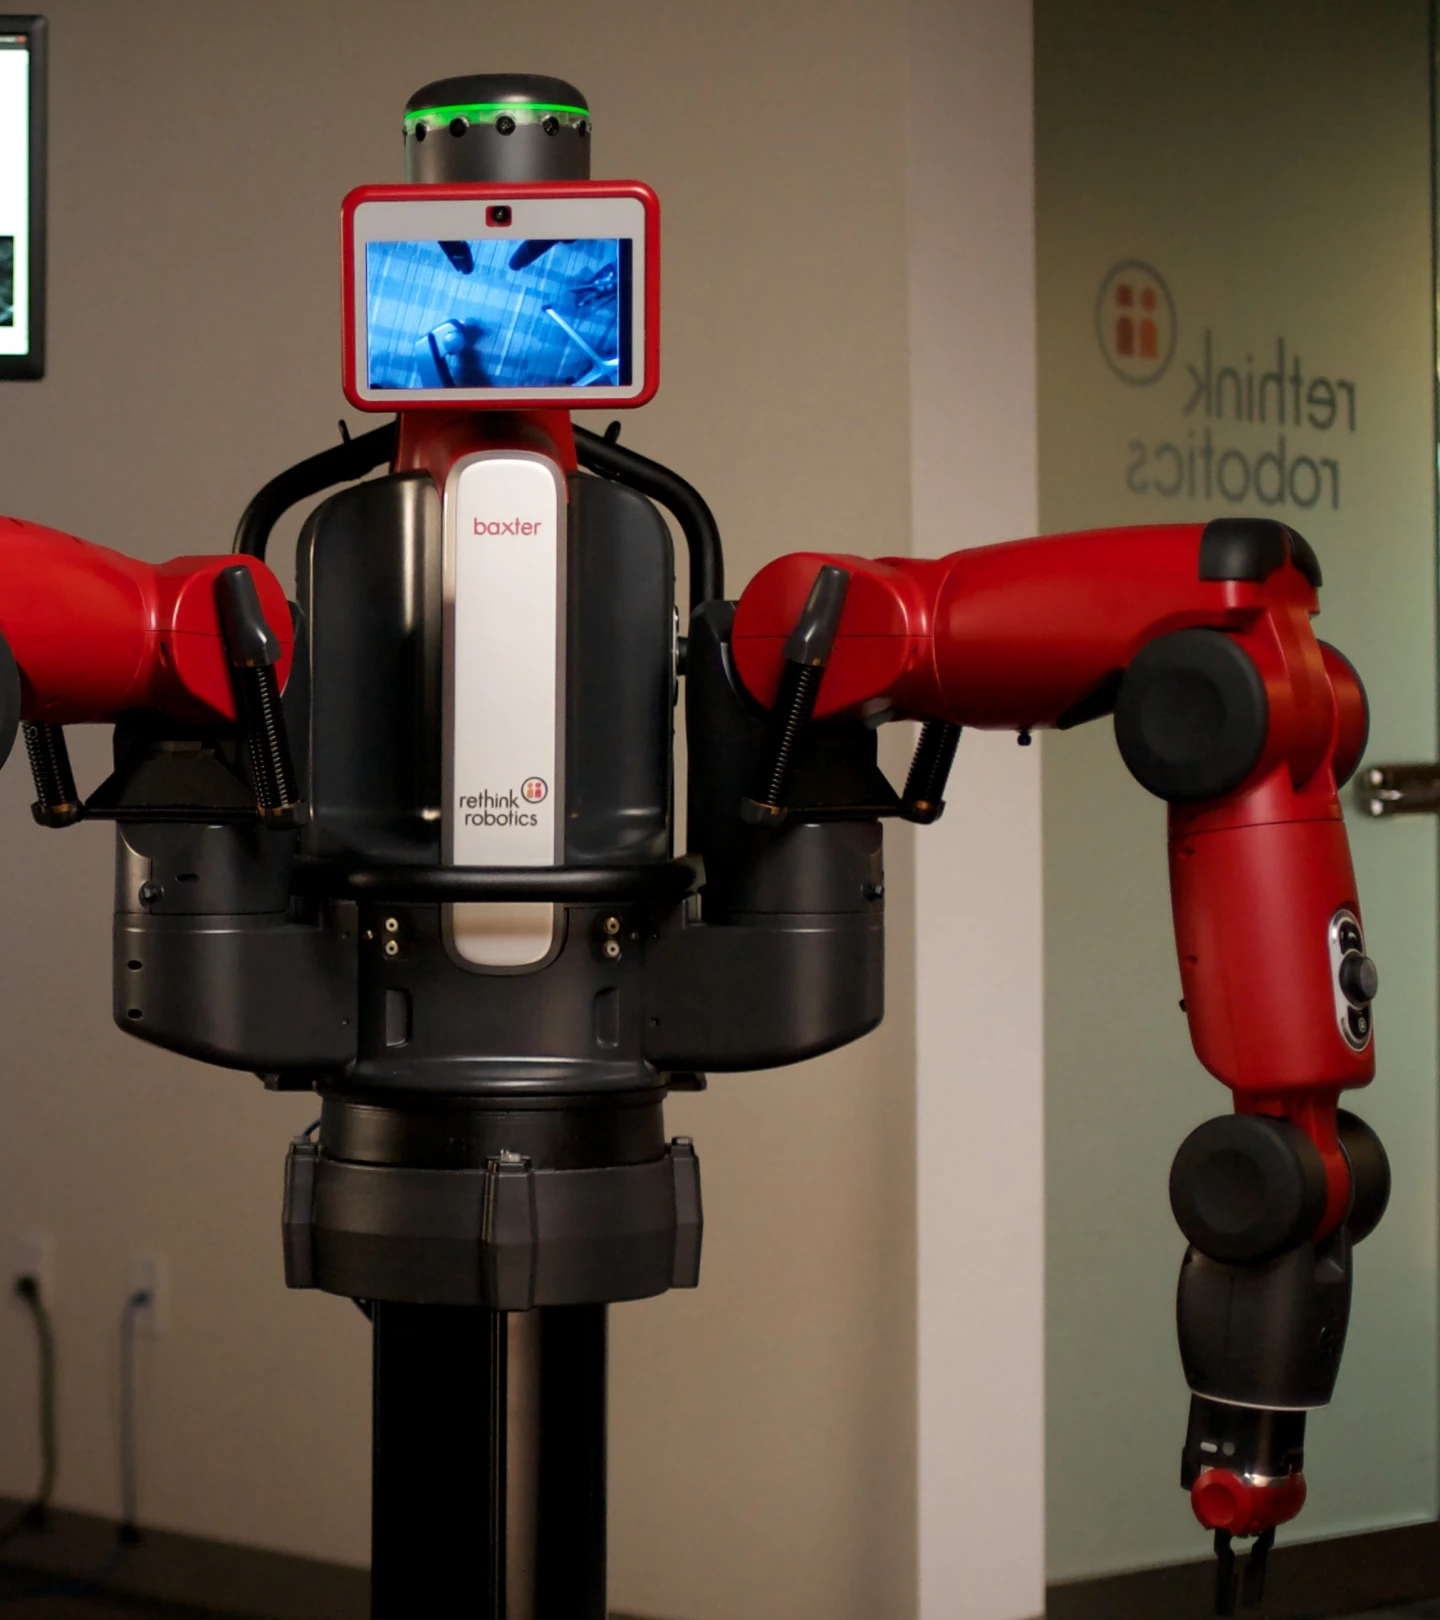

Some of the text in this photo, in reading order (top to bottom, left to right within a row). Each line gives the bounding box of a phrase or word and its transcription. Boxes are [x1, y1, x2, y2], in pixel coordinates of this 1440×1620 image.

[473, 516, 542, 536] baxter
[459, 788, 519, 809] rethink
[465, 809, 538, 827] robotics
